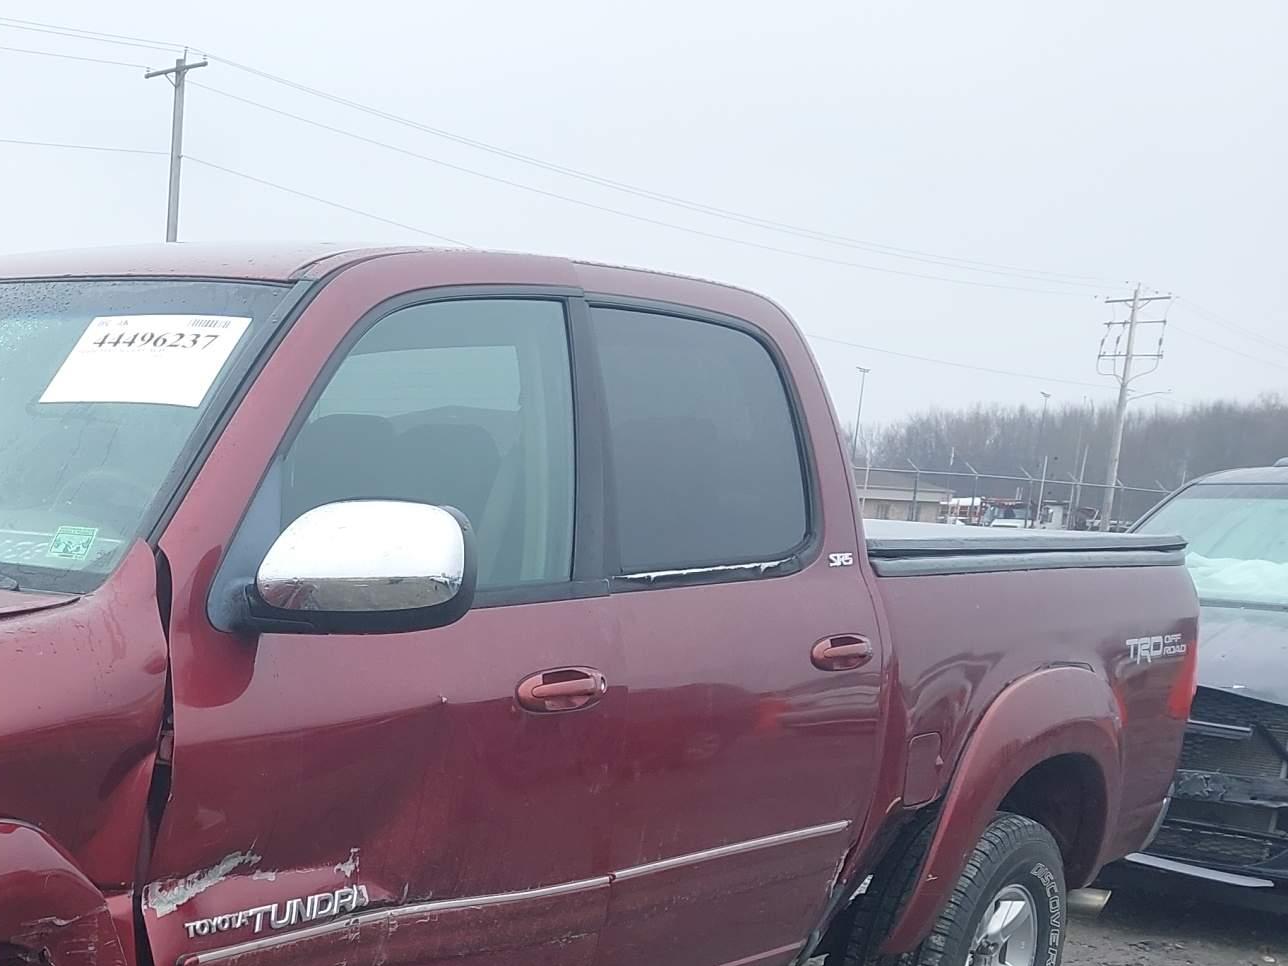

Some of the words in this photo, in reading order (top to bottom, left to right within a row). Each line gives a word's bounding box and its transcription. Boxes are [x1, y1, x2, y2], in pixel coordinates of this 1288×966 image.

[92, 332, 220, 350] 44496237
[1125, 635, 1163, 664] TRD
[1164, 633, 1182, 644] OFF
[1163, 644, 1187, 655] ROAD
[184, 911, 249, 938] TOYOTA
